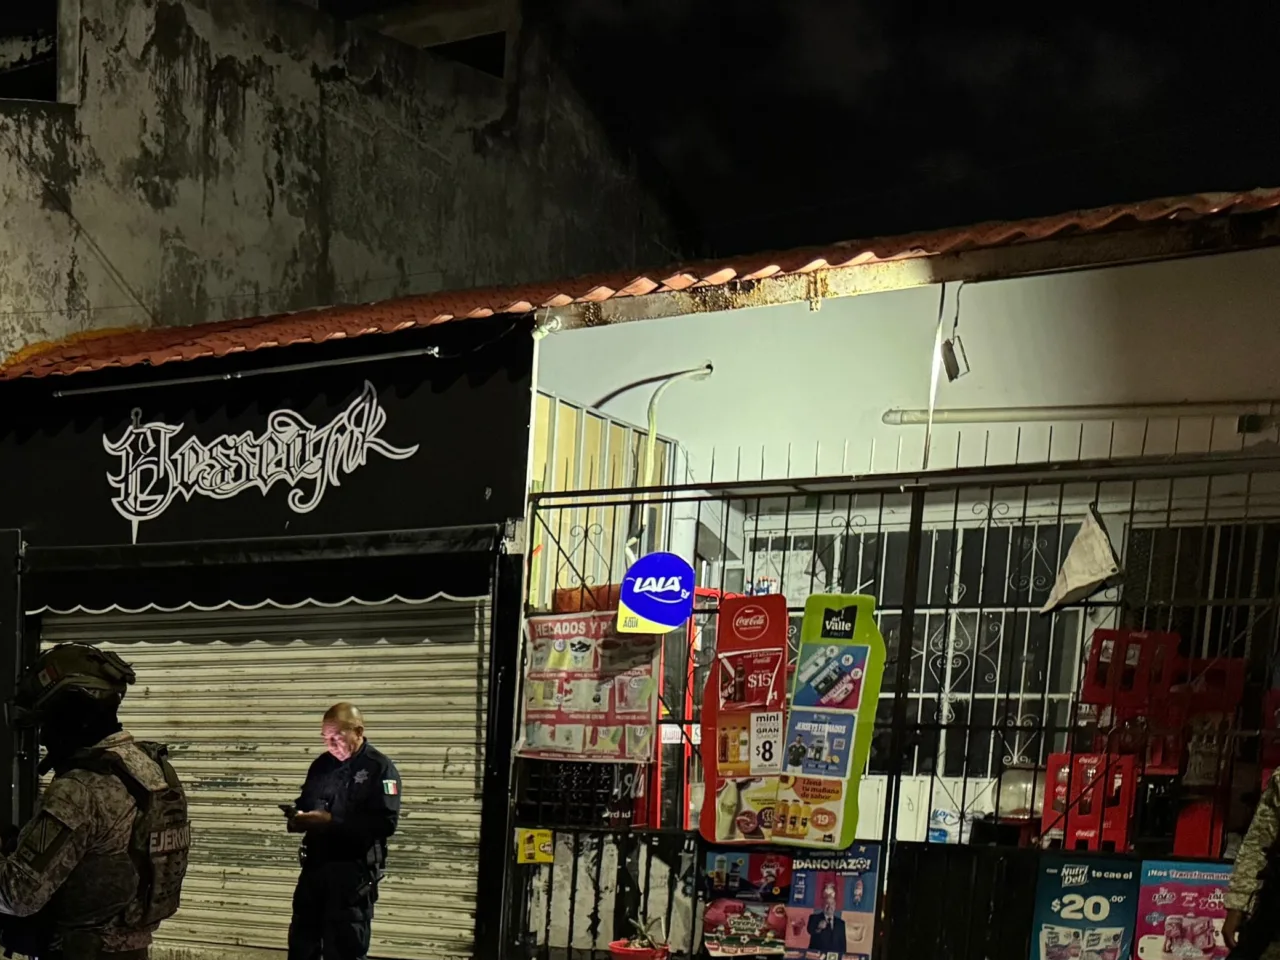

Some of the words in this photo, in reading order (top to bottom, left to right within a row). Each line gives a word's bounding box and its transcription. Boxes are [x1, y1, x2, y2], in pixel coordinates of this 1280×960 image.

[633, 576, 681, 594] LALA
[535, 621, 587, 637] HELADOS
[589, 621, 599, 634] Y
[825, 620, 852, 631] Valle
[756, 713, 779, 722] mini
[1091, 869, 1102, 878] te
[1104, 872, 1122, 880] cae
[1123, 871, 1133, 881] el
